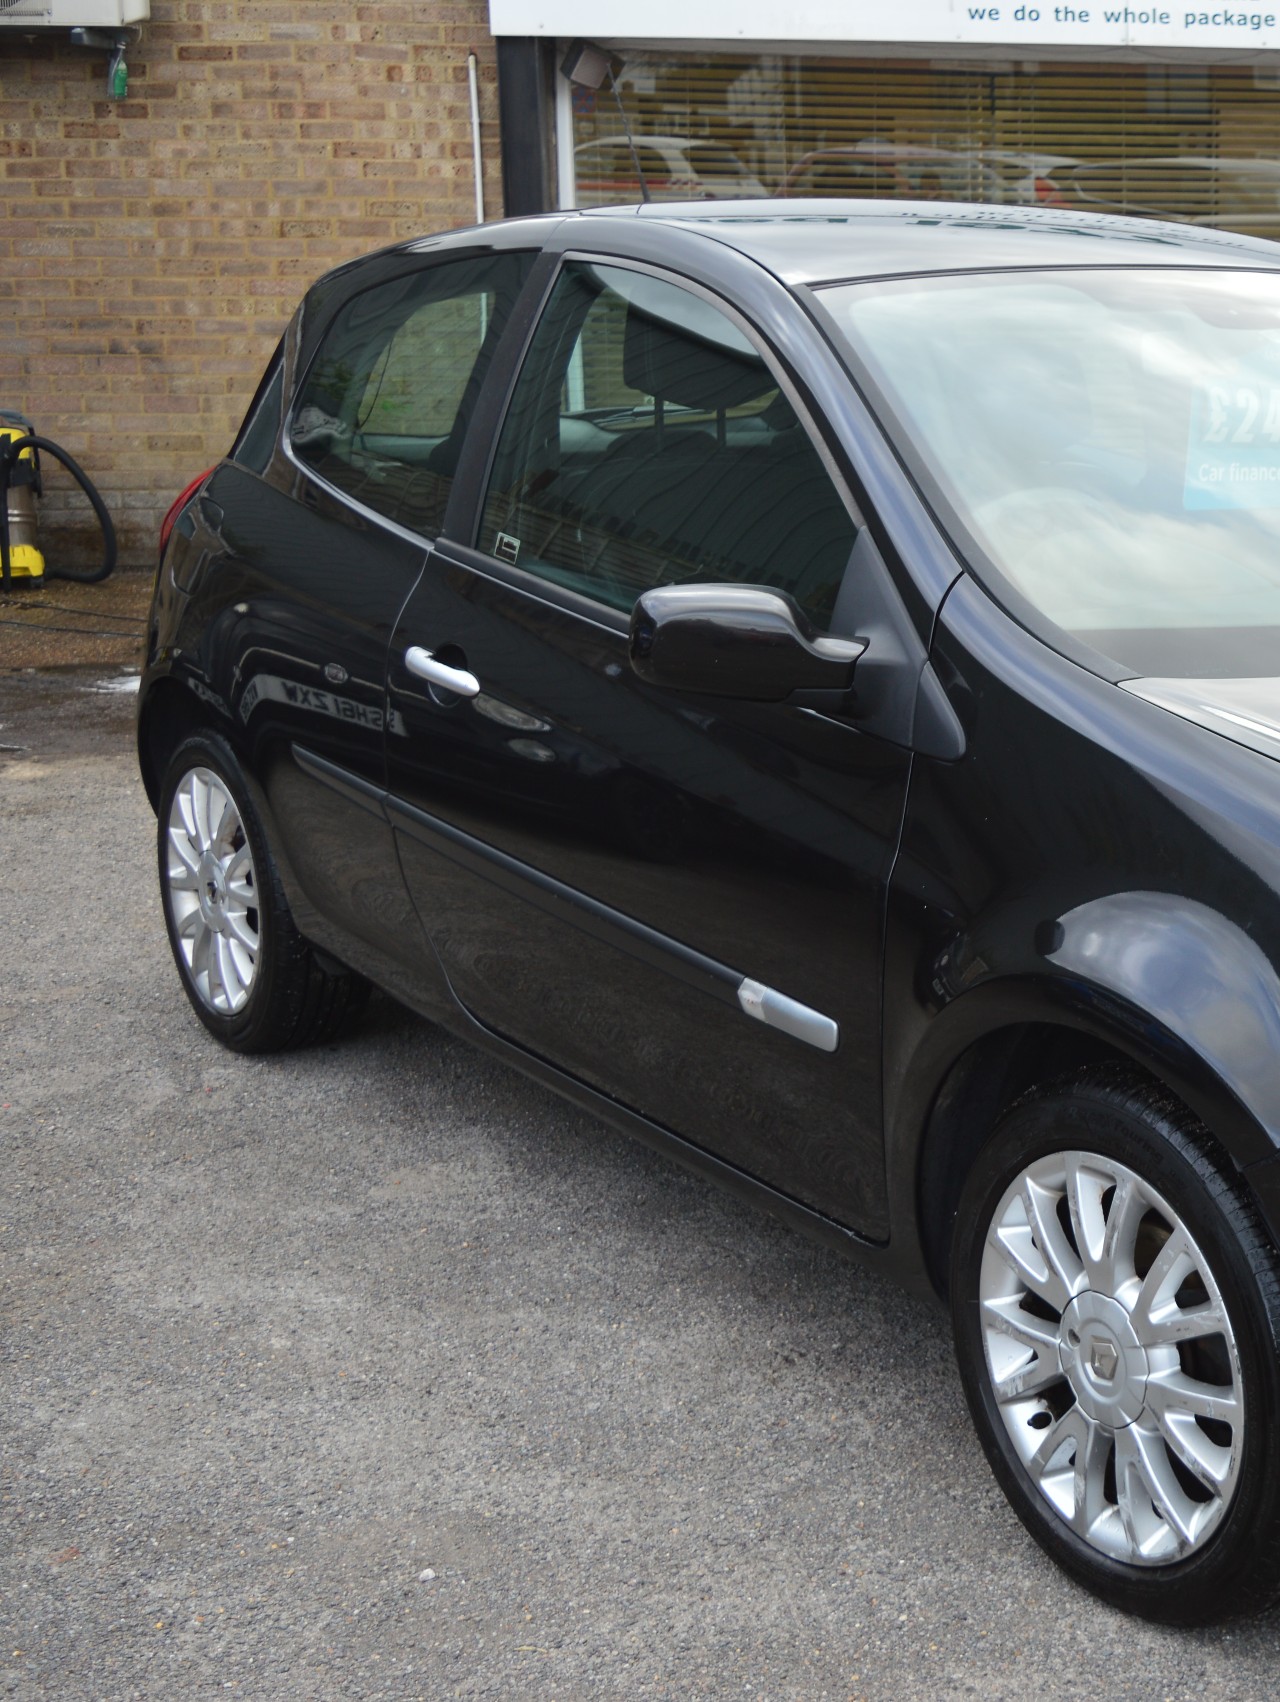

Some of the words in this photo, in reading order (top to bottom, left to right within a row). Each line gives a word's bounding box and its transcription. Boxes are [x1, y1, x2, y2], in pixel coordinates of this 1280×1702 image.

[968, 7, 1000, 20] we
[1014, 5, 1040, 22] do
[1054, 6, 1090, 22] the
[1104, 8, 1171, 24] whole
[1184, 9, 1276, 30] package
[1200, 464, 1225, 482] Car
